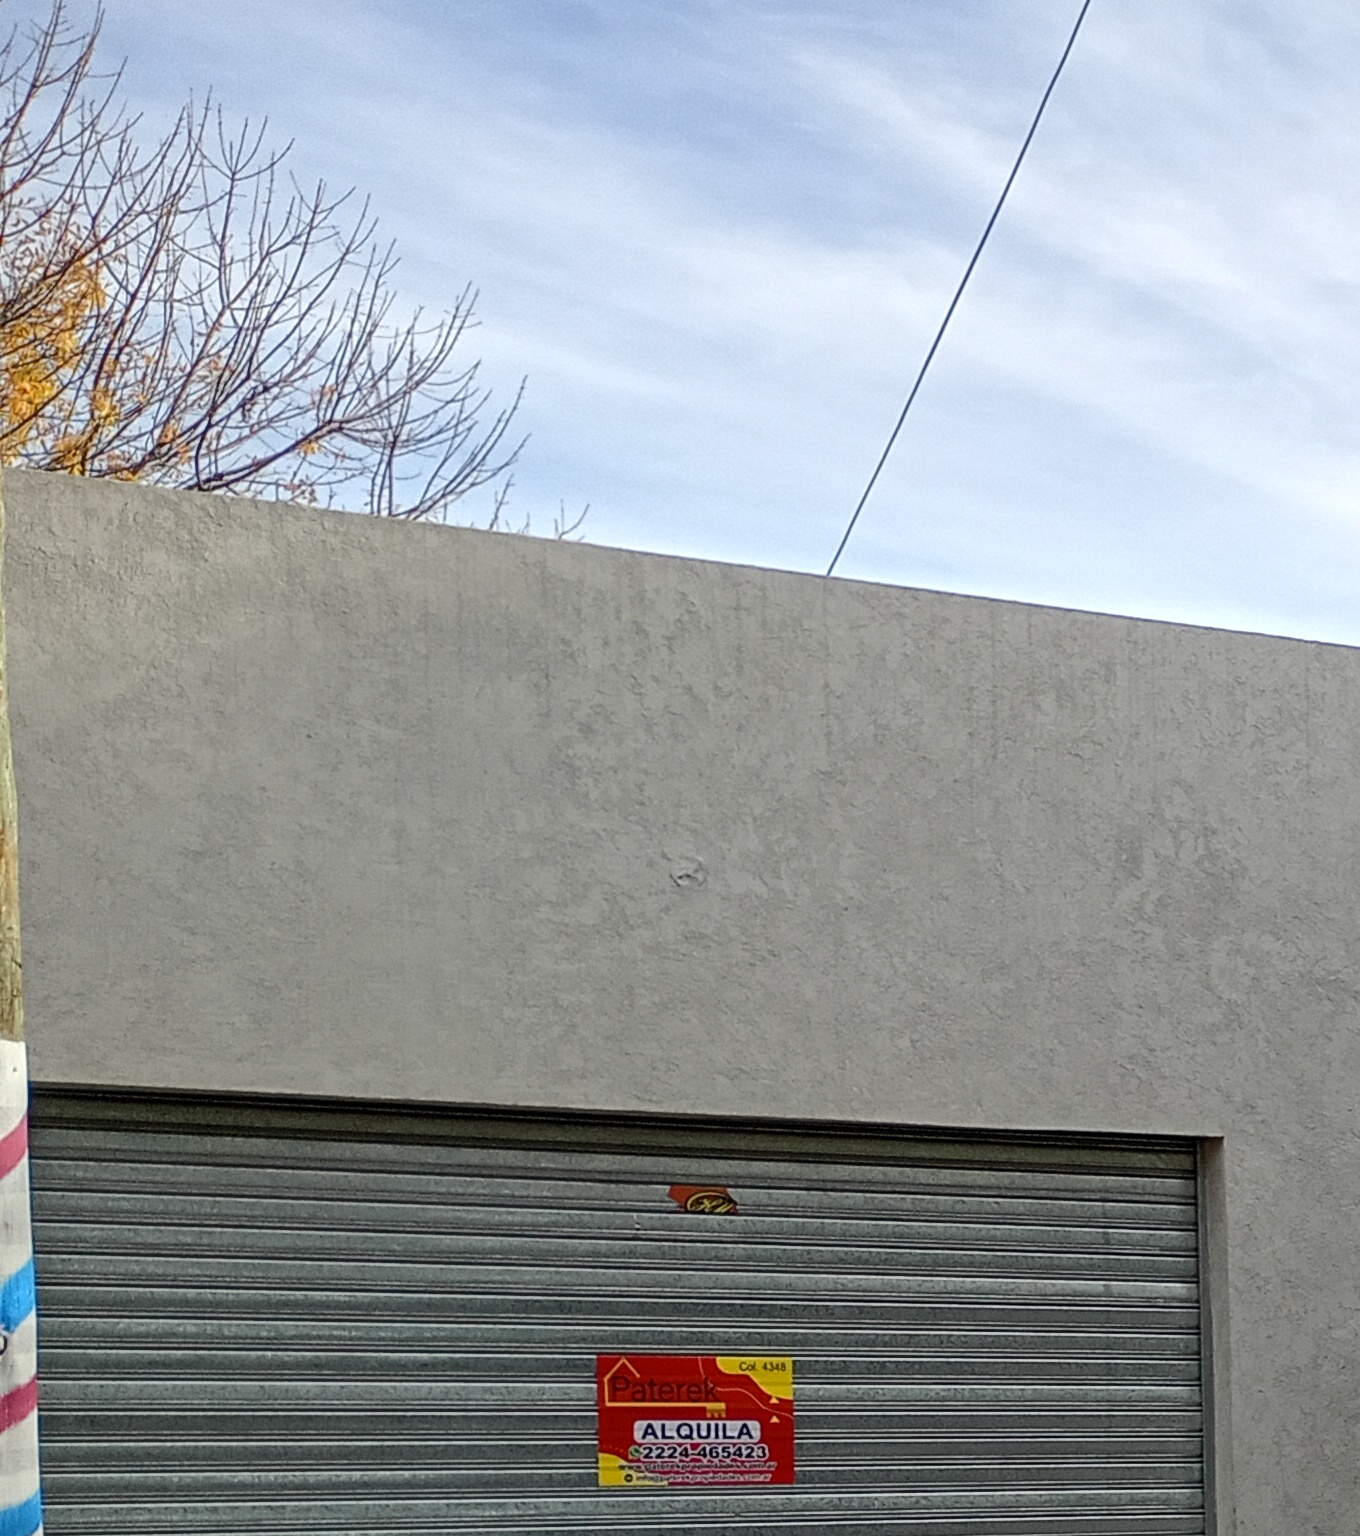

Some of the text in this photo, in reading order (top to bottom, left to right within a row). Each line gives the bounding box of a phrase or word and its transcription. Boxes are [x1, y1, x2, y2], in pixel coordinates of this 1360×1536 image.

[739, 1361, 787, 1372] Col. 4348
[611, 1375, 720, 1402] Paterek
[641, 1423, 754, 1441] ALQUILA
[642, 1446, 767, 1459] 2224-465423
